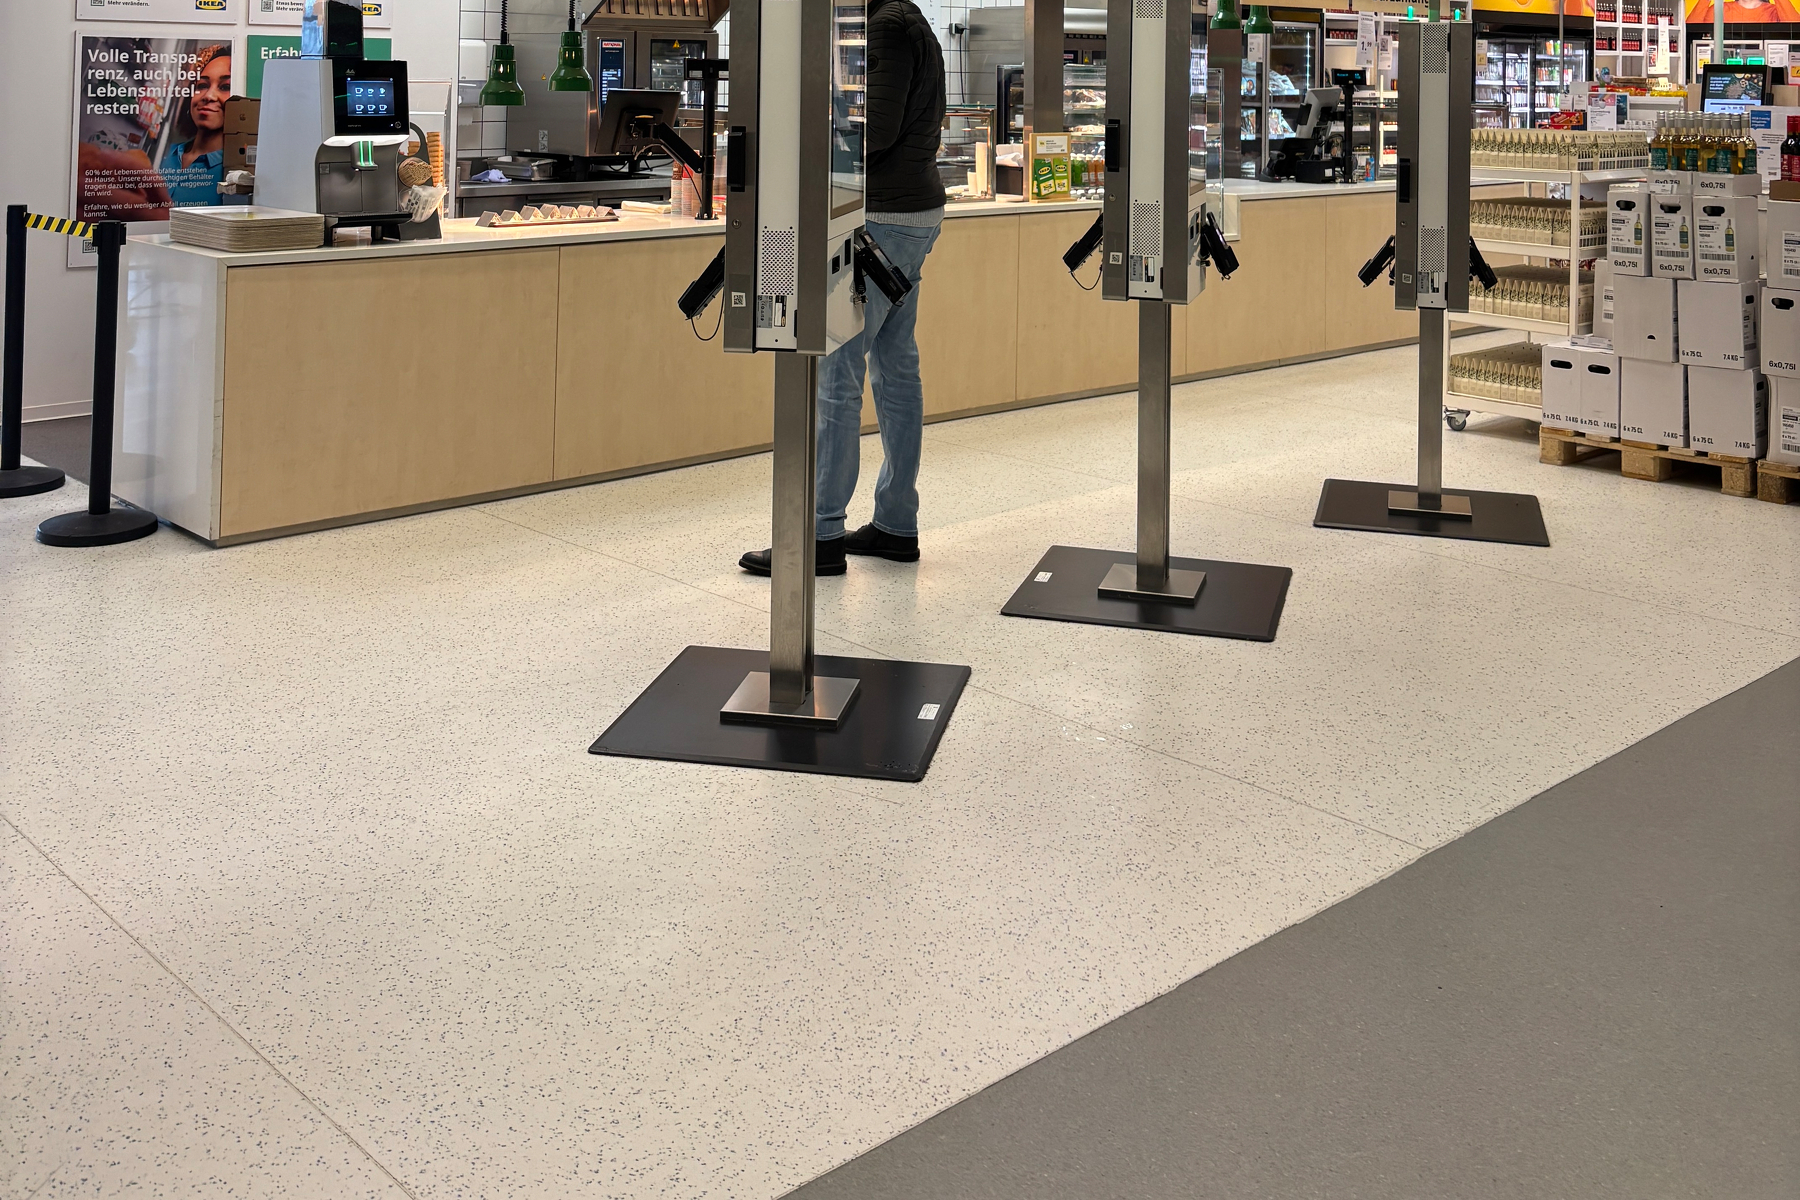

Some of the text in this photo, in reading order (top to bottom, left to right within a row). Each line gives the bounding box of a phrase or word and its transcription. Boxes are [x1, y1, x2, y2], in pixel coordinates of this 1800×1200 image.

[88, 49, 203, 66] Volle Transpa-
[87, 67, 201, 82] renz, auch bei
[87, 83, 200, 98] Lebensmittel-
[86, 101, 139, 115] resten
